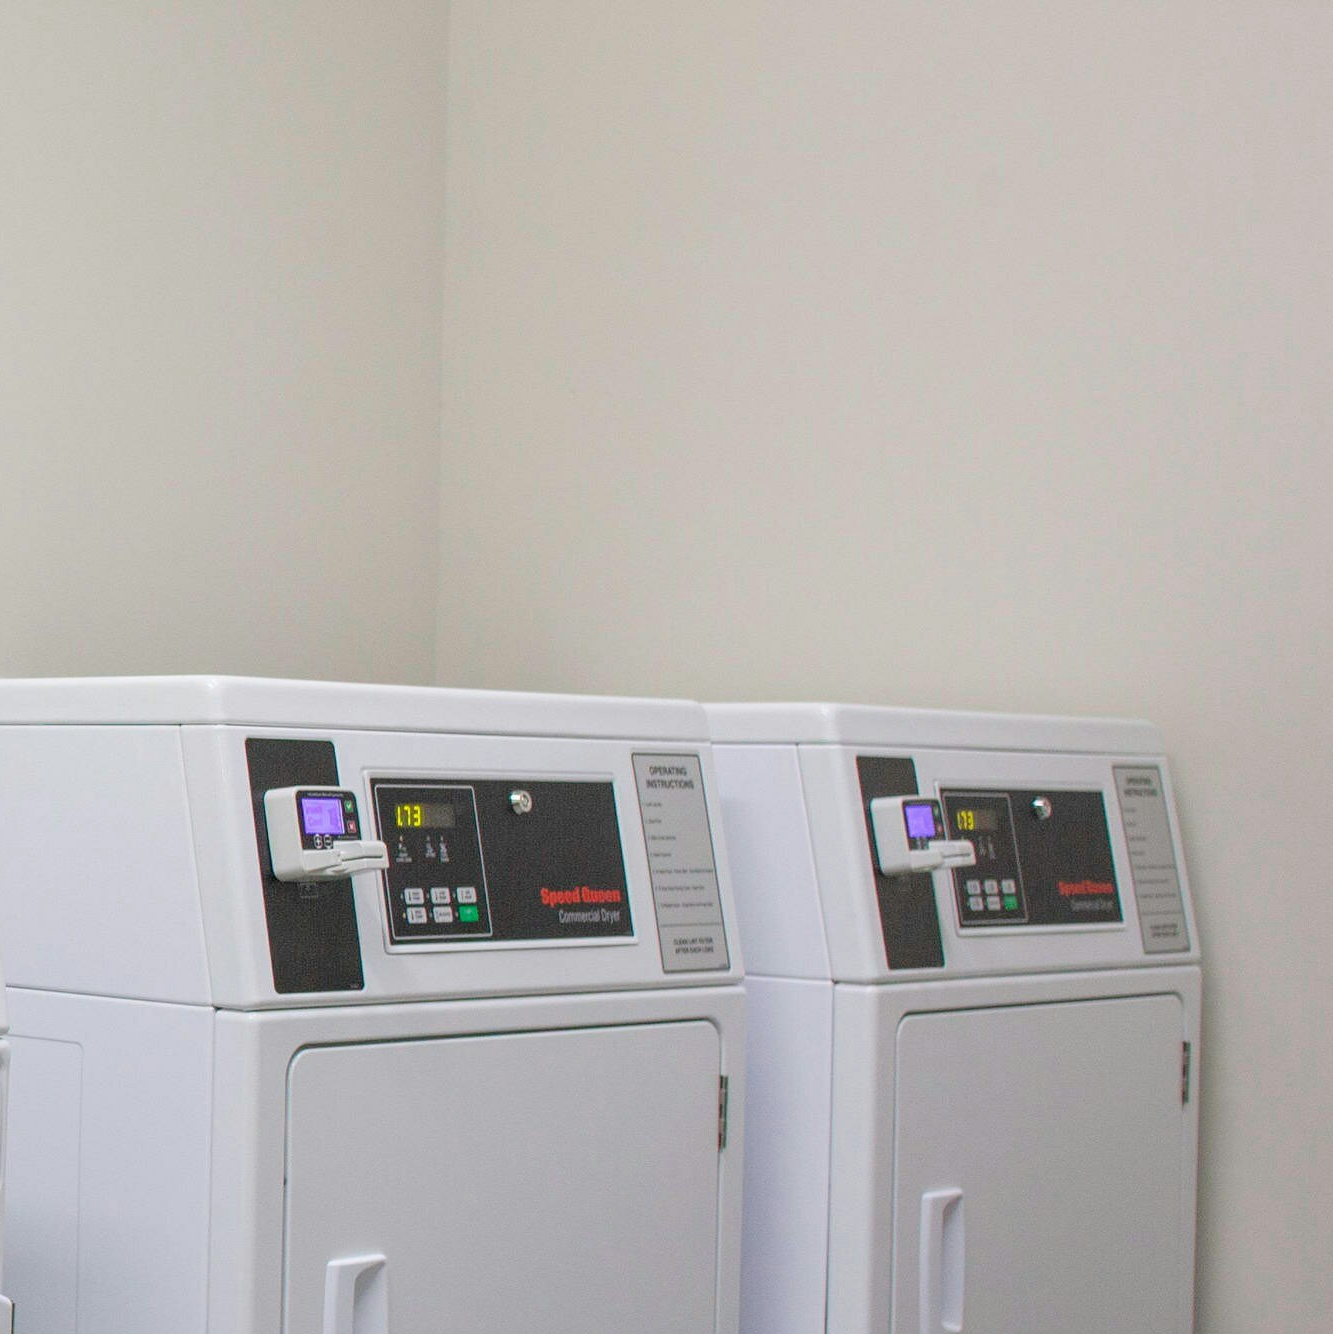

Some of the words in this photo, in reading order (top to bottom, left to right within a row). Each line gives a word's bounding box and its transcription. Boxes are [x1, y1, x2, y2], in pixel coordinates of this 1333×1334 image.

[649, 767, 687, 776] OPERATING
[646, 780, 694, 789] INSTRUCTIONS
[540, 887, 580, 907] Speed
[582, 887, 621, 903] Queen
[559, 910, 600, 923] Commercial
[602, 910, 621, 924] Dryer
